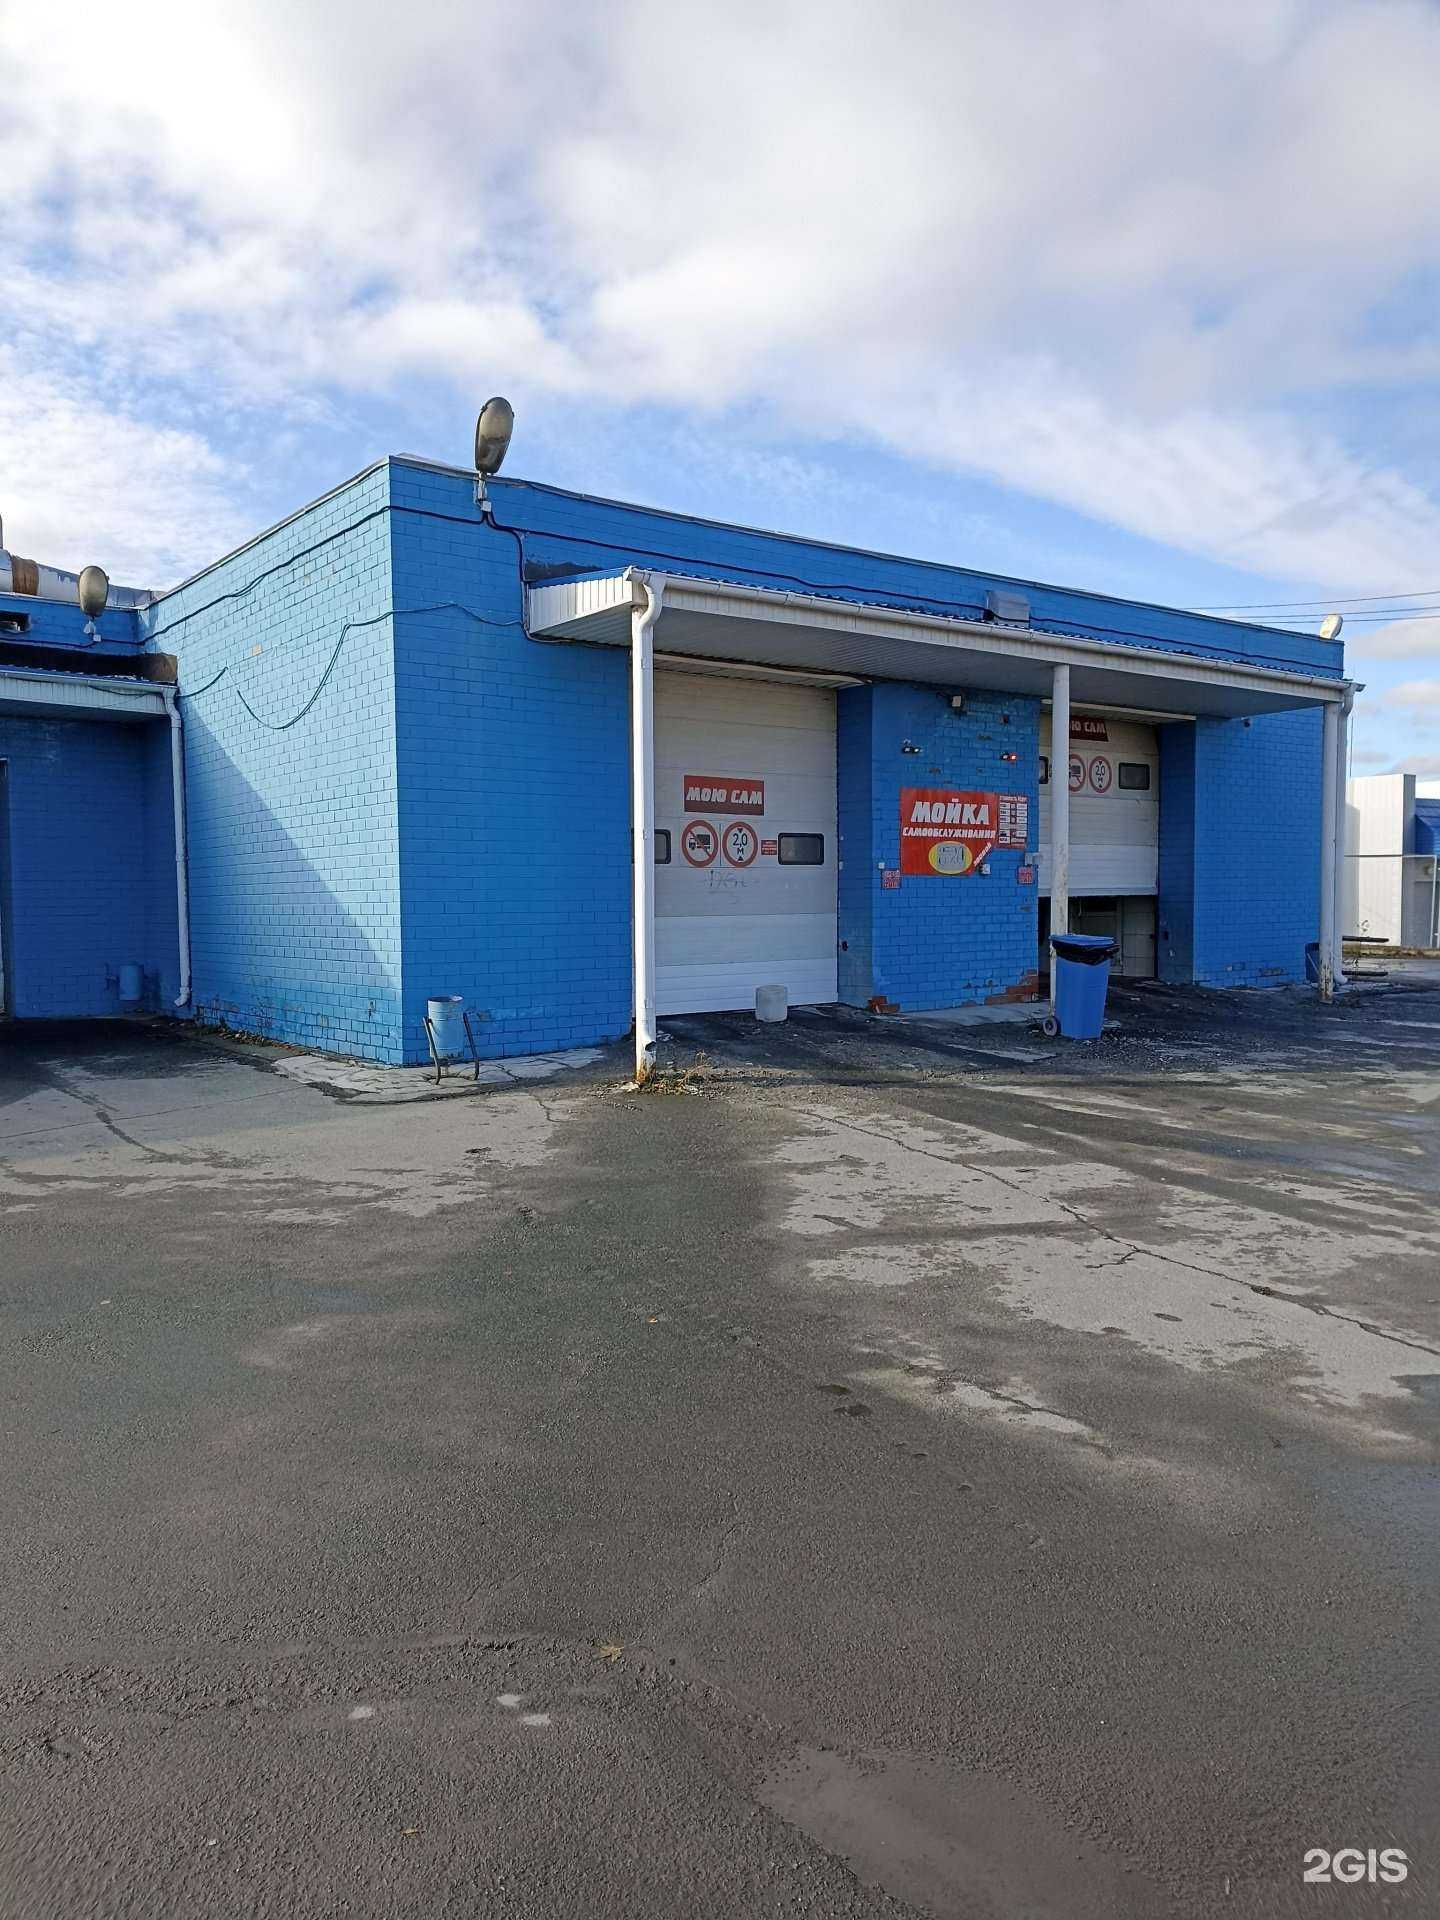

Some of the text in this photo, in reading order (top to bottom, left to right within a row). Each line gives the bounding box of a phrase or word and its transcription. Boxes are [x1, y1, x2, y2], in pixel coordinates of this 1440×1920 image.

[686, 786, 763, 805] МОЮ САМ
[910, 798, 991, 825] МОЙКА
[733, 833, 749, 848] 2,0
[902, 826, 996, 839] САМООБСЛУЖИВАНИЯ
